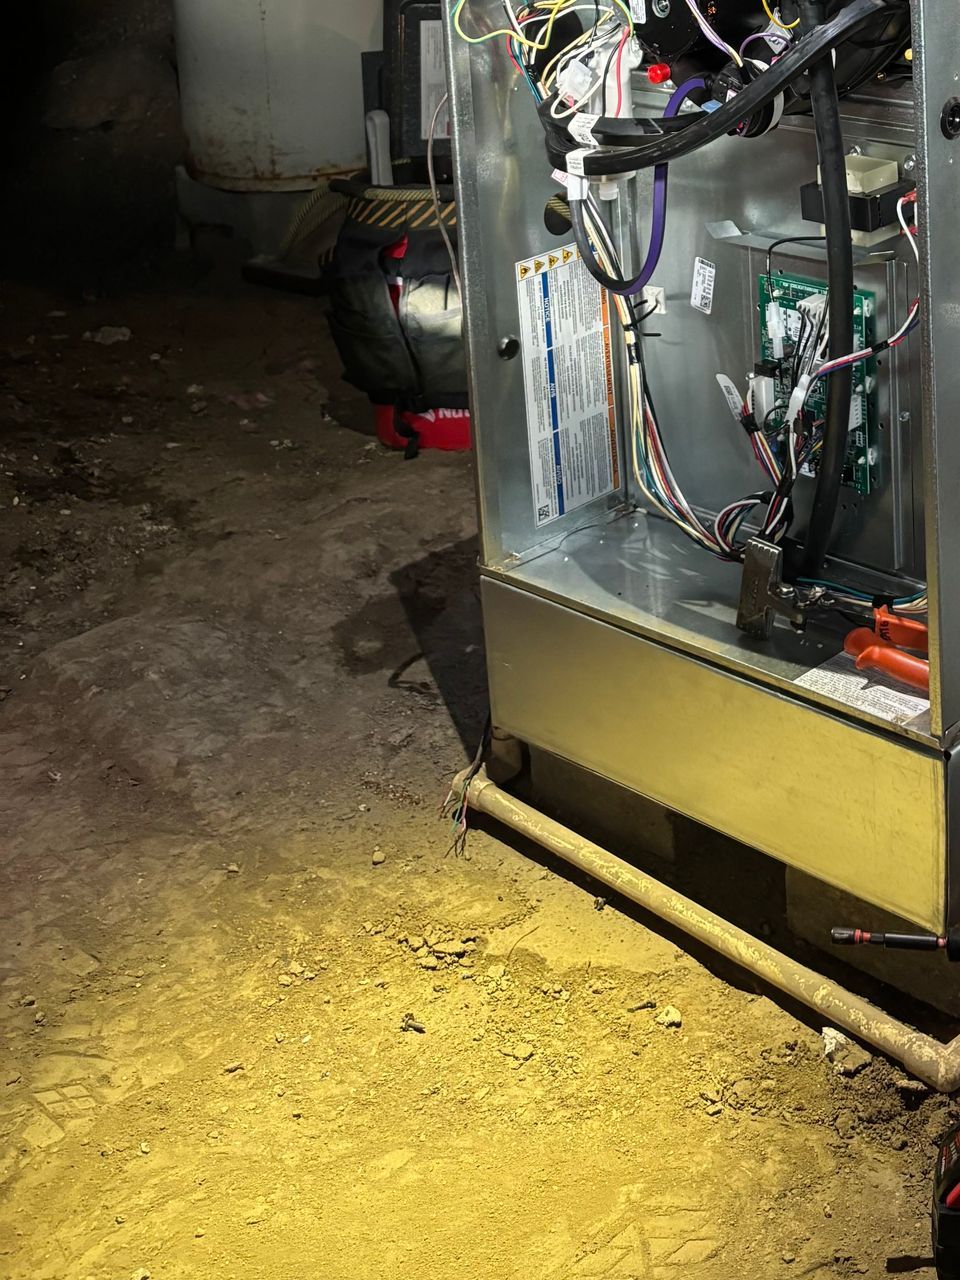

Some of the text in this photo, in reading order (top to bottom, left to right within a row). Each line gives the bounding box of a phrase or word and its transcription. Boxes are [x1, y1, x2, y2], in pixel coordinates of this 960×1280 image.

[543, 297, 552, 323] NOTICE
[603, 340, 613, 396] AVERTISSEMENT
[549, 382, 557, 399] AVIS
[555, 464, 563, 486] AVISO
